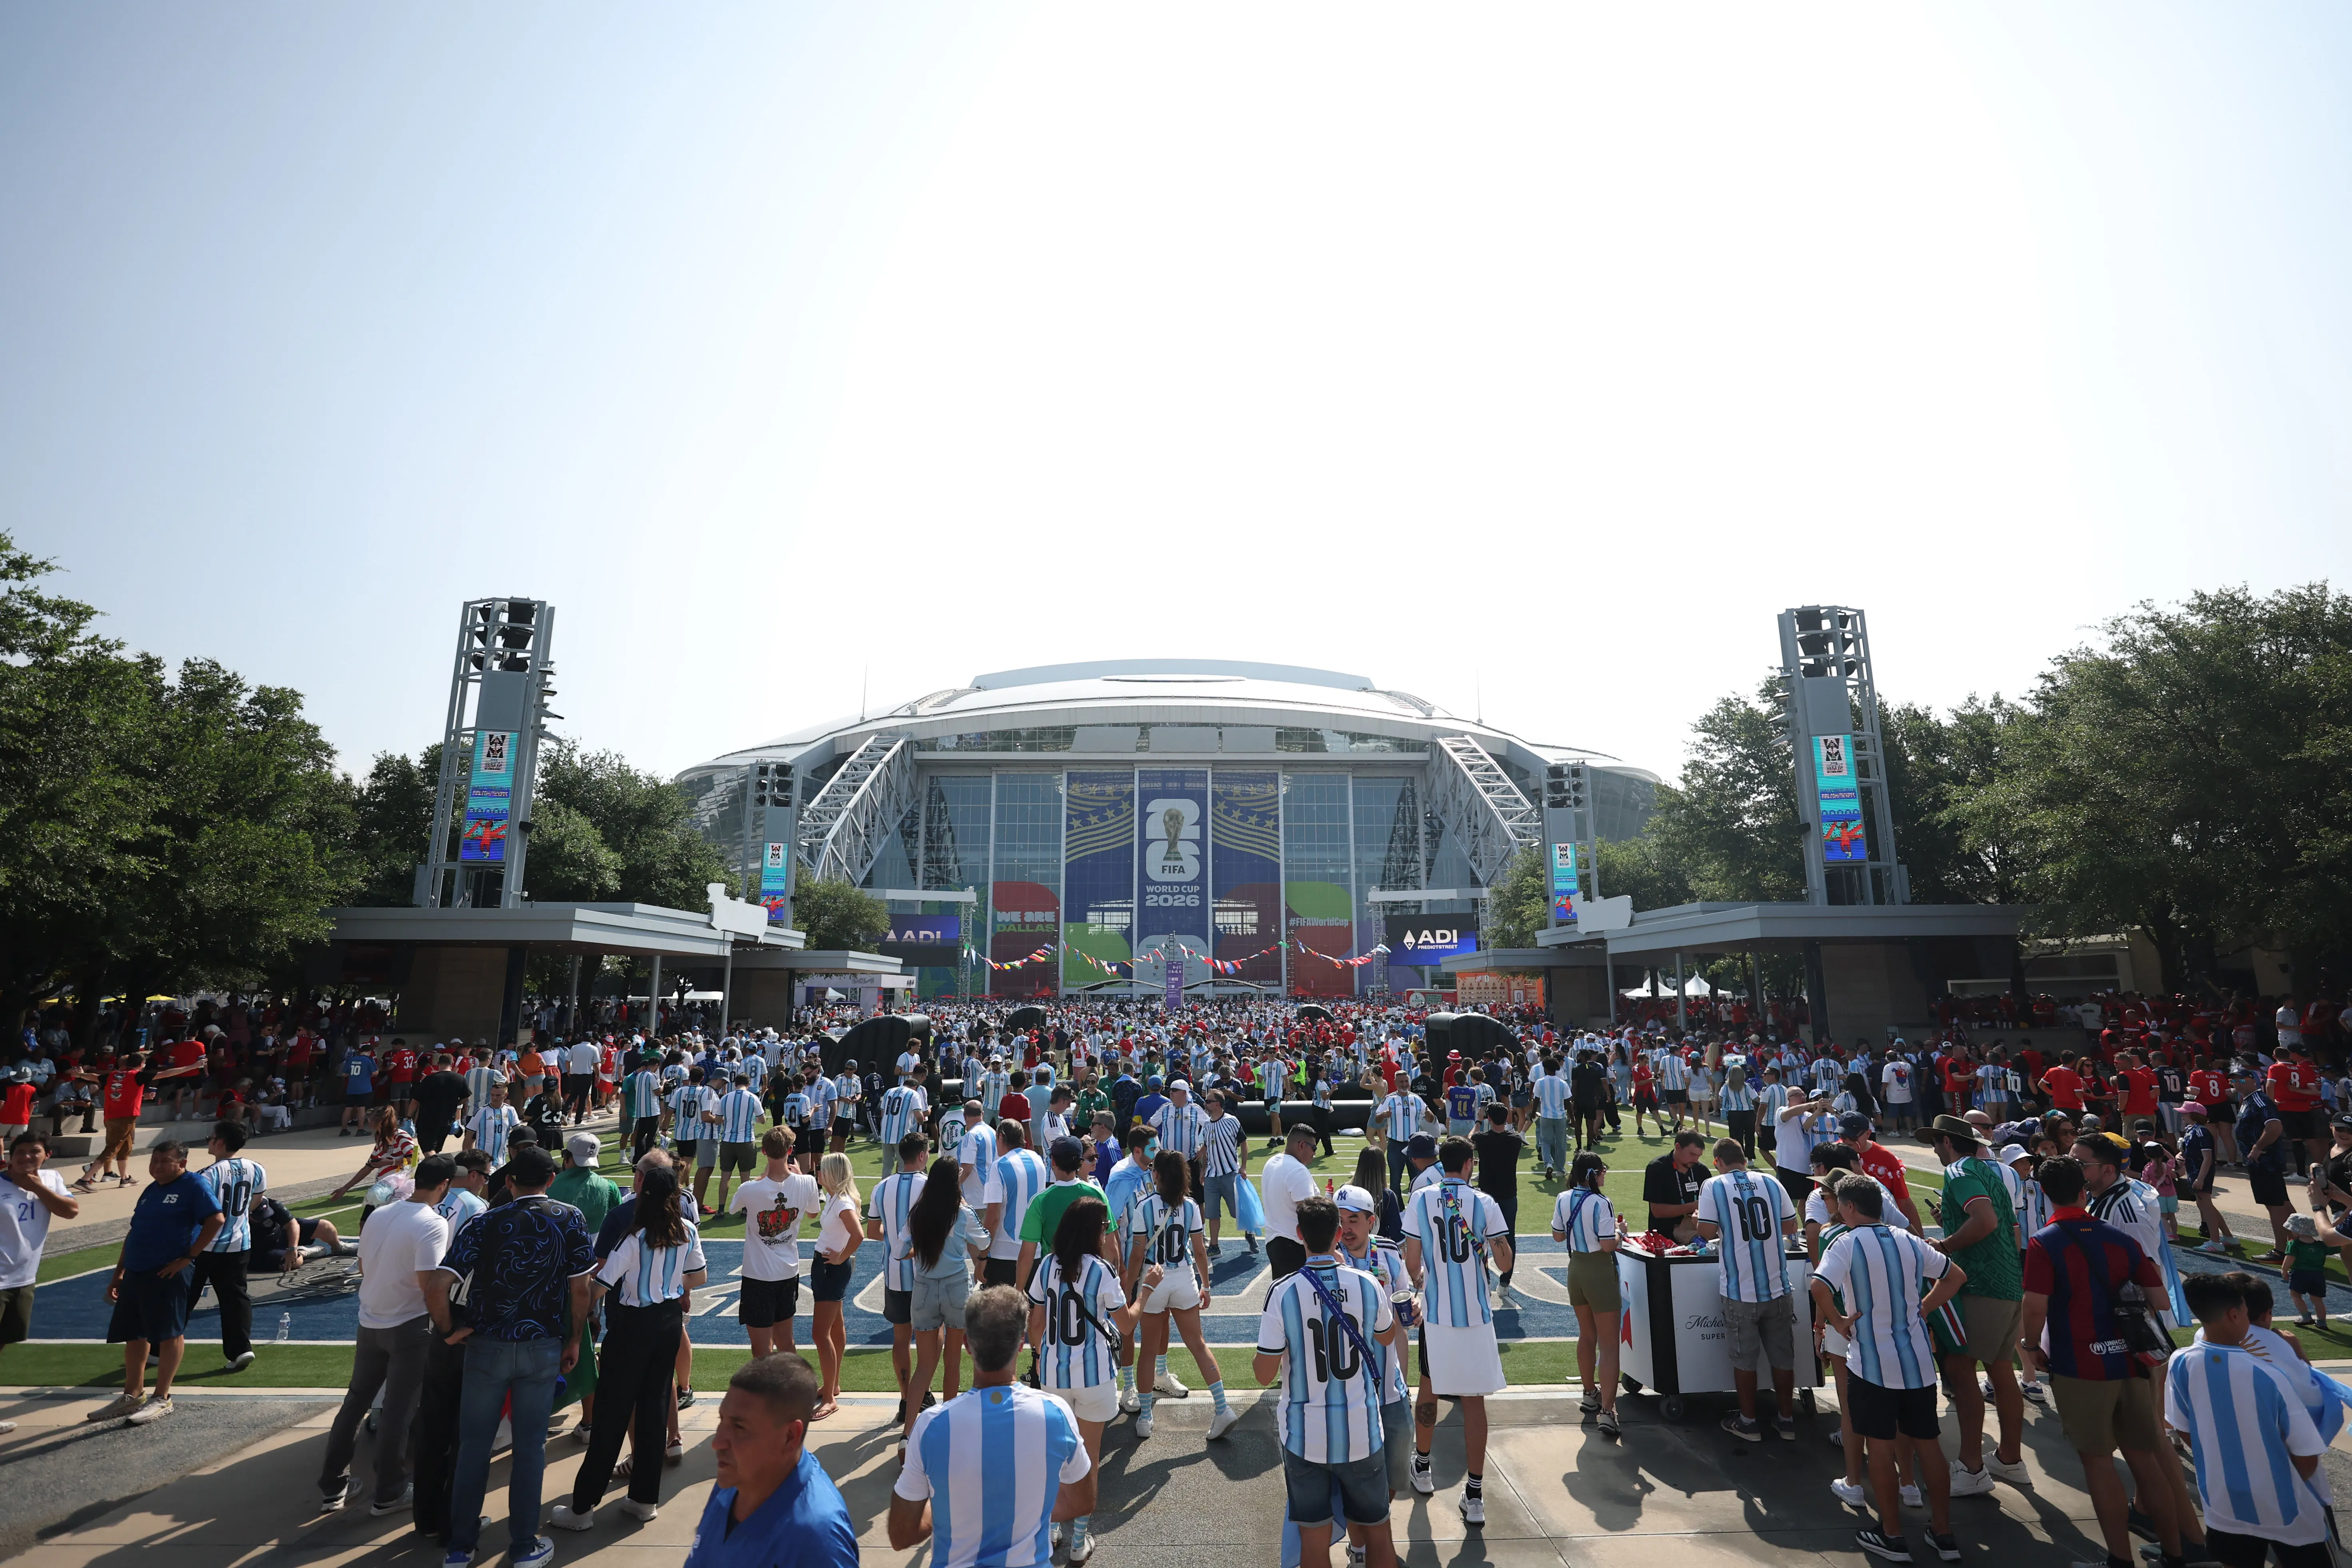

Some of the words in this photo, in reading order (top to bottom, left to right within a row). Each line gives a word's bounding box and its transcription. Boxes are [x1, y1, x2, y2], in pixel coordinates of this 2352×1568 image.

[1162, 866, 1185, 874] FIFA
[1145, 895, 1200, 906] 2026
[997, 911, 1021, 922] WE
[1289, 917, 1348, 927] #FIFAWorldCup
[996, 924, 1055, 932] DALLAS
[902, 930, 941, 945] ADI
[1418, 929, 1458, 944] ADI
[940, 1047, 946, 1056] 10
[1019, 1041, 1026, 1050] 10
[404, 1056, 414, 1069] 32
[351, 1065, 361, 1075] 10
[750, 1065, 757, 1078] 8
[1821, 1067, 1833, 1080] 10
[1514, 1077, 1523, 1091] 10
[2006, 1075, 2021, 1092] 10
[2164, 1075, 2181, 1092] 10
[2209, 1080, 2219, 1097] 8
[682, 1100, 697, 1118] 10
[886, 1096, 902, 1116] 10
[1402, 1107, 1410, 1116] 10
[1458, 1100, 1468, 1116] 11
[494, 1124, 502, 1134] 10
[1733, 1182, 1758, 1191] MESSI
[162, 1194, 179, 1203] ES
[222, 1181, 251, 1217] 10
[1337, 1190, 1347, 1201] NY
[18, 1201, 35, 1222] 21
[1733, 1196, 1771, 1242] 10
[1153, 1224, 1185, 1264] 10
[1433, 1215, 1469, 1264] 10
[1046, 1287, 1086, 1346] 10
[1307, 1313, 1360, 1383] 10
